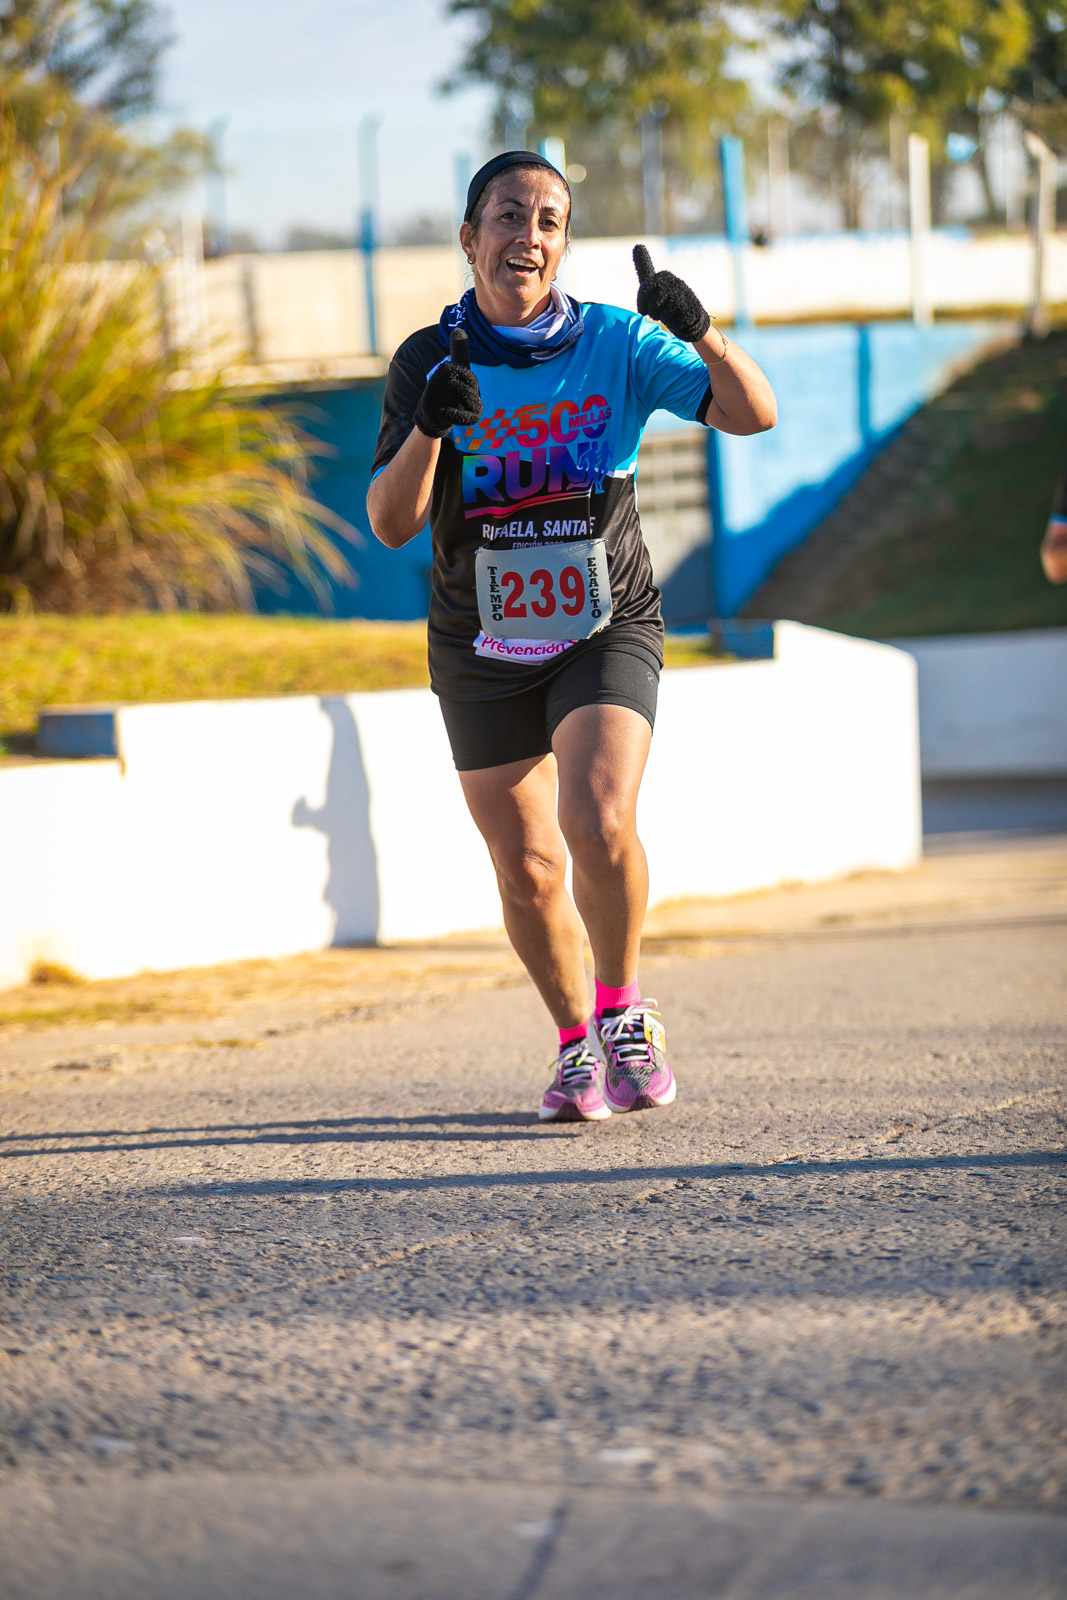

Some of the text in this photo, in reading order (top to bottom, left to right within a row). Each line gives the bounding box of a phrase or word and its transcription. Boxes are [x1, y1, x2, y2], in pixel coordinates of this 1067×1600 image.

[568, 407, 612, 429] MILLAS
[462, 443, 594, 504] RUN
[542, 519, 588, 537] SANTA
[487, 566, 503, 621] TIEMPO
[501, 565, 586, 618] 239
[586, 557, 602, 619] EXACTO
[481, 636, 566, 656] Prevención
